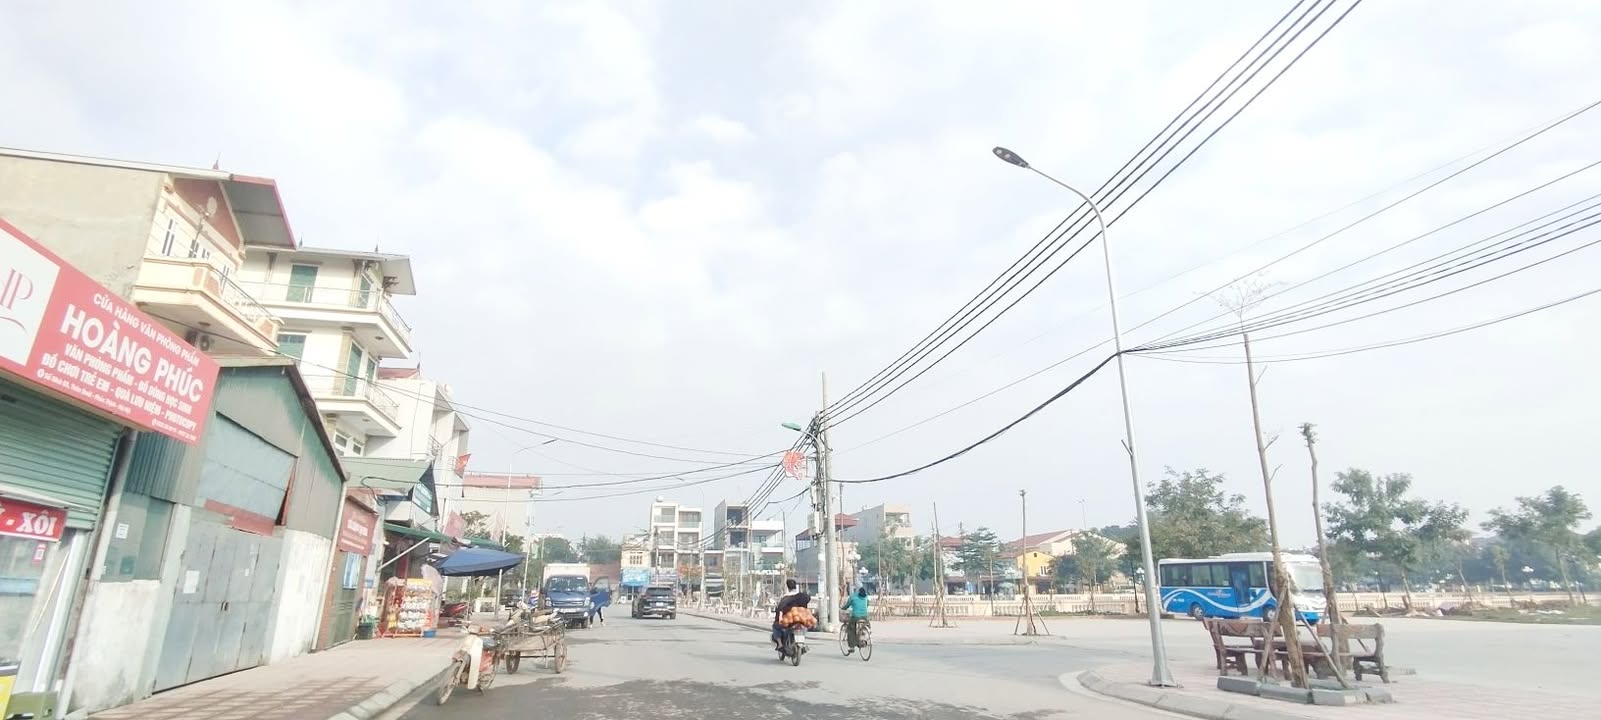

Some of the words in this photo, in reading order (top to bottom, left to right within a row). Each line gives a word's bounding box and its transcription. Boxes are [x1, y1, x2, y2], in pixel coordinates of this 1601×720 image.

[93, 293, 113, 313] CỬA
[114, 306, 140, 328] HÀNG
[140, 322, 156, 340] VĂN
[156, 332, 181, 355] PHÒNG
[60, 304, 152, 374] HOÀNG
[153, 357, 204, 402] PHÚC
[64, 343, 84, 362] VĂN
[83, 353, 112, 375] PHÒNG
[57, 360, 80, 379] CHƠI
[96, 377, 111, 392] EM
[16, 509, 57, 536] XÔI
